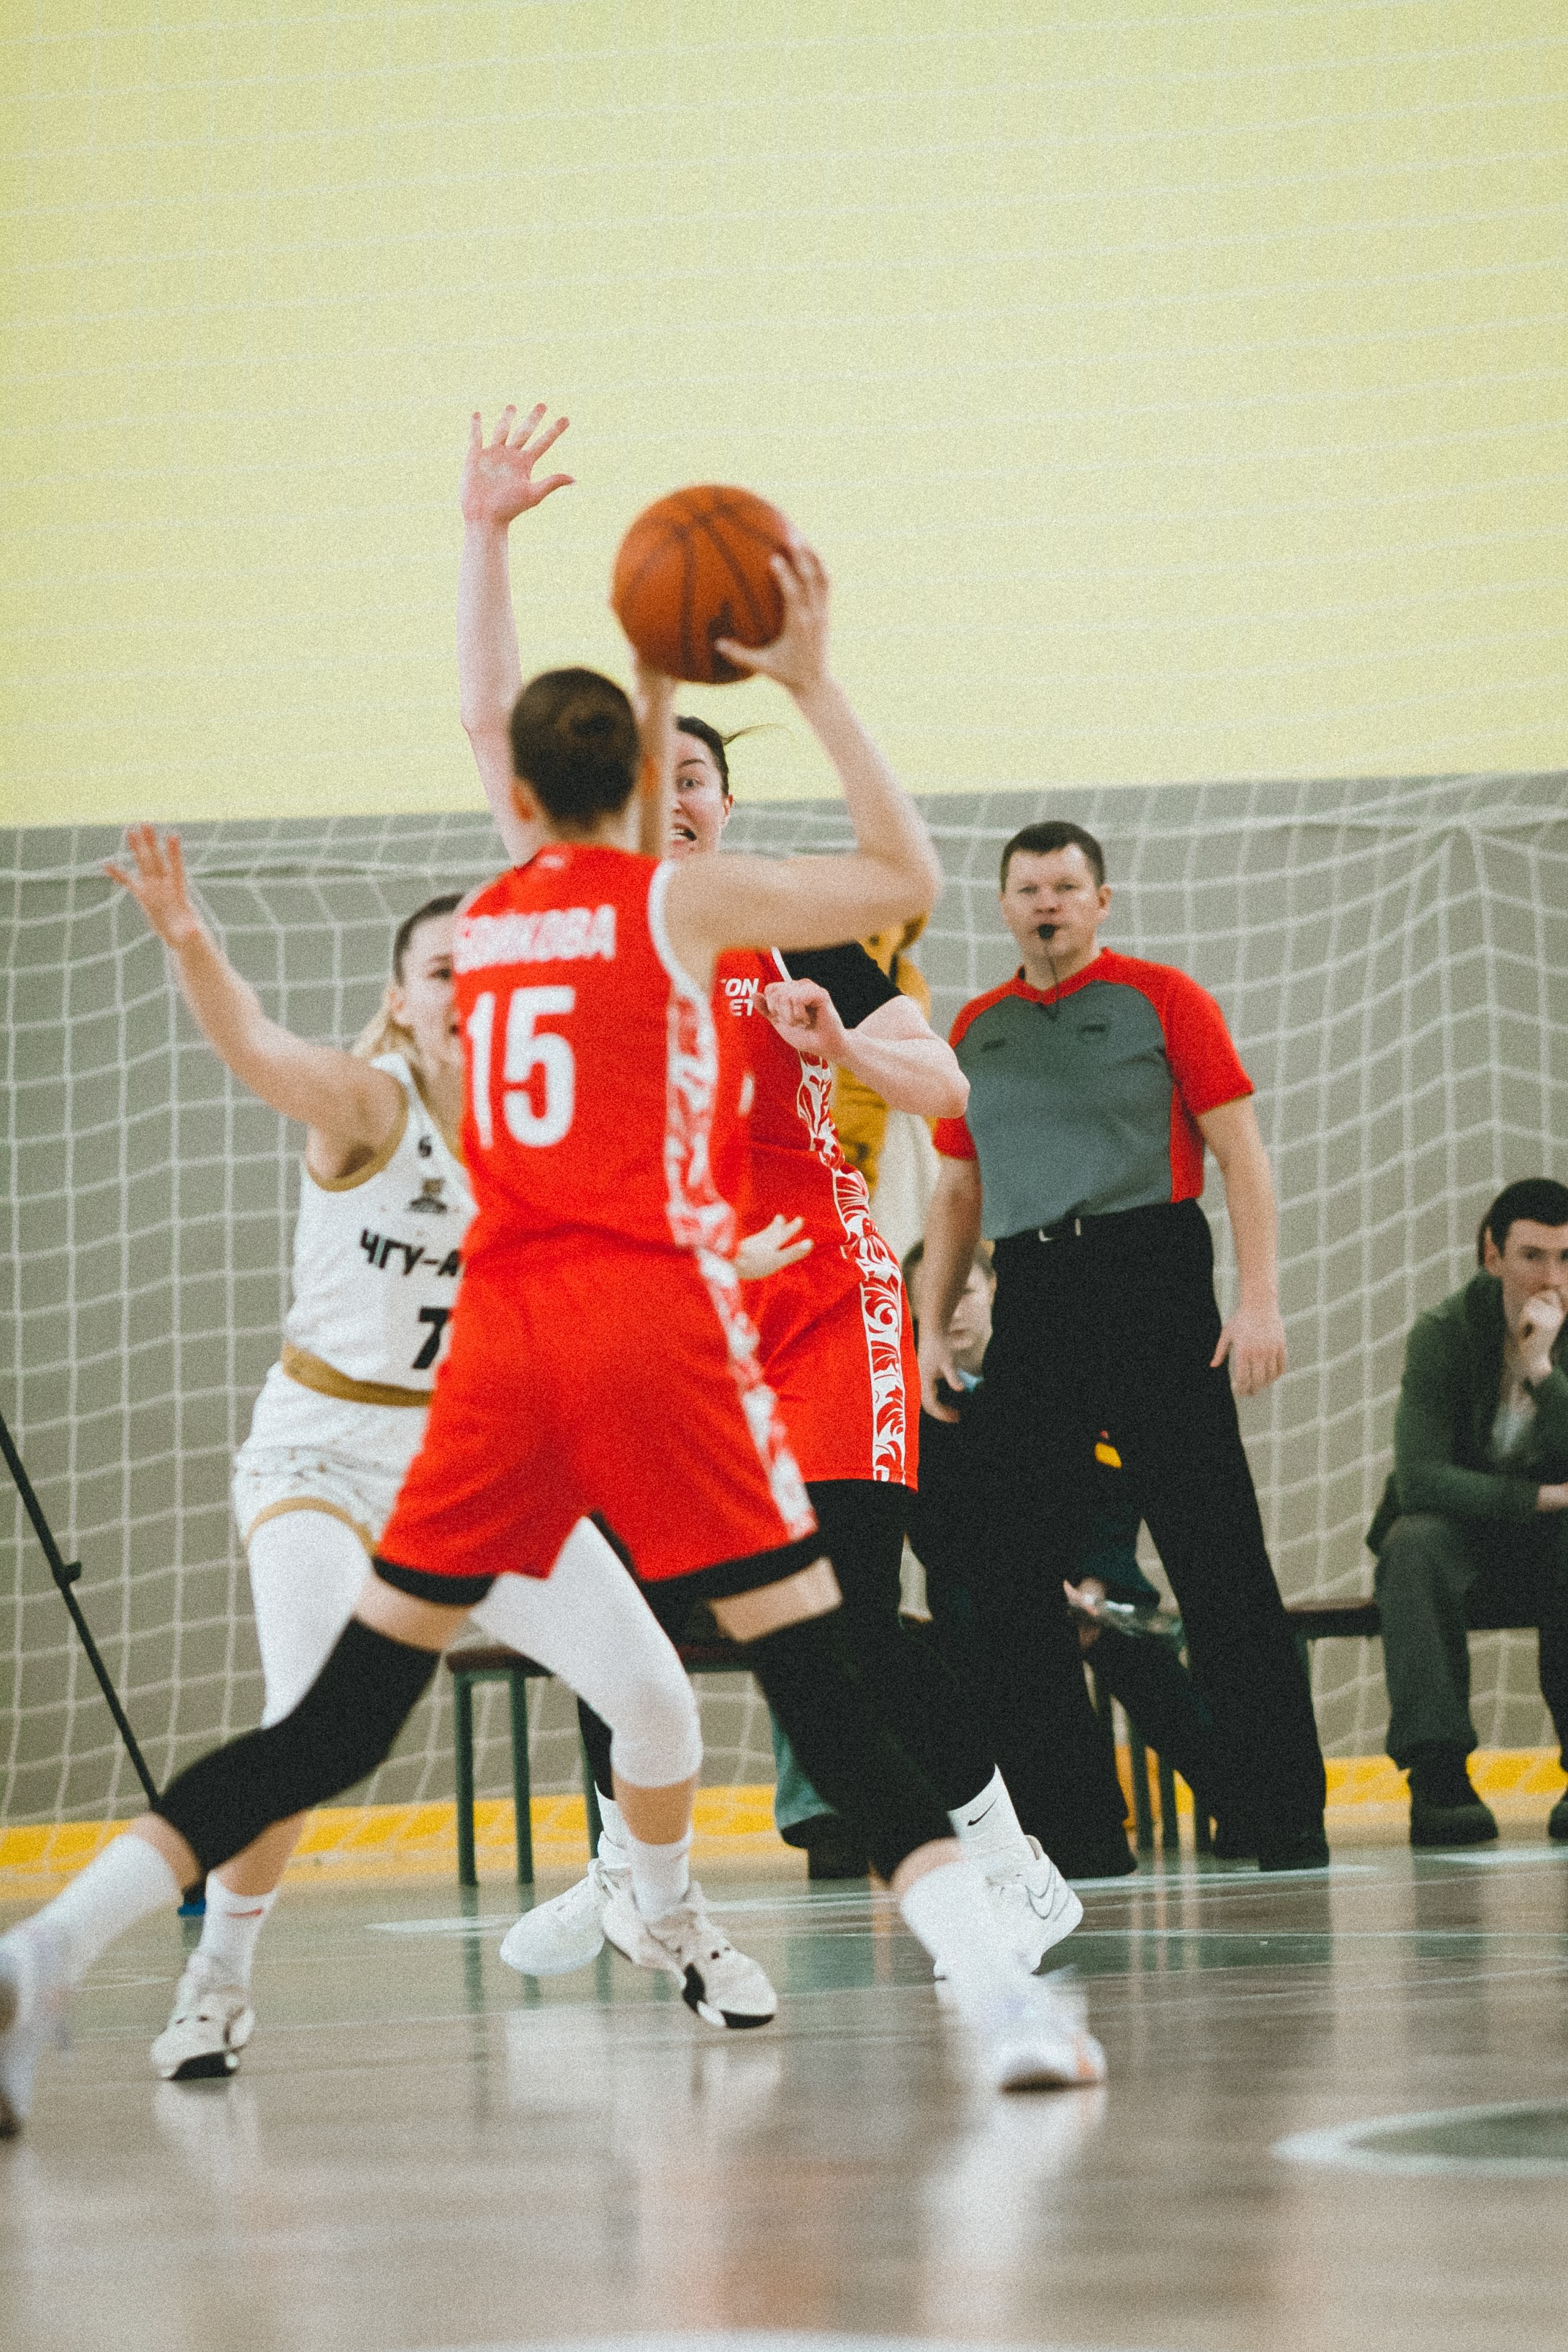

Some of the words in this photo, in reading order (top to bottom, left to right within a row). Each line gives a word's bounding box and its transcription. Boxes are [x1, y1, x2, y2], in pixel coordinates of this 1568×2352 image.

[720, 978, 760, 997] ON
[467, 984, 575, 1150] 15
[413, 1307, 452, 1370] 7
